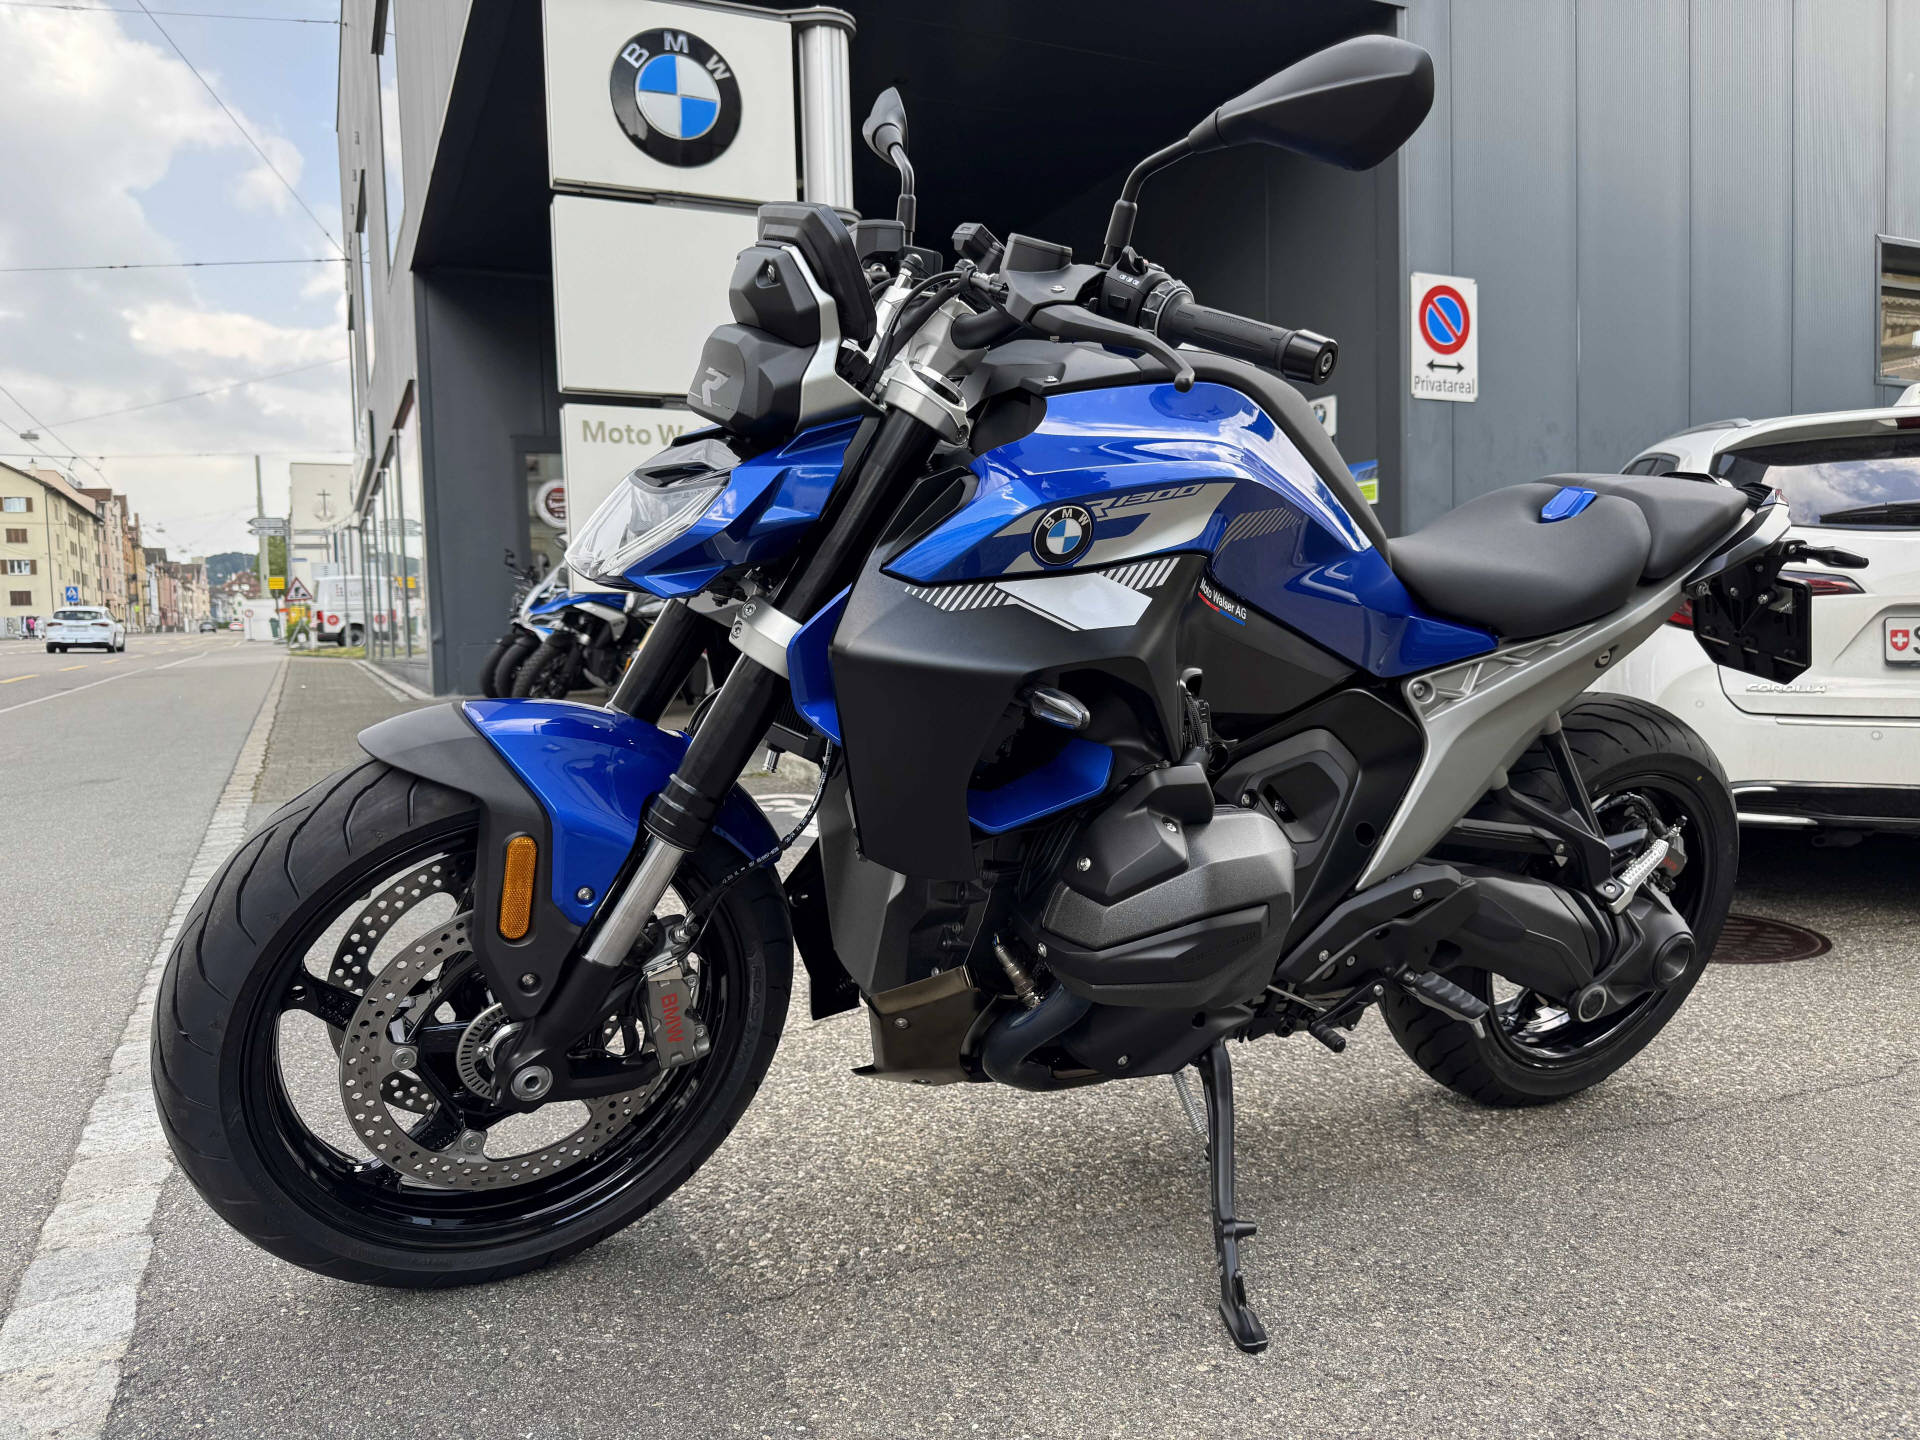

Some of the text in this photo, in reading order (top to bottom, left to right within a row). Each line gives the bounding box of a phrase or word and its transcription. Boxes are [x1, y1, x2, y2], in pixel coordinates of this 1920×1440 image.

[621, 30, 732, 81] BMW
[1414, 376, 1475, 394] Privatareal
[581, 420, 652, 445] Moto
[1042, 508, 1090, 529] BMW
[1199, 576, 1248, 620] Moto Walser AG
[1745, 683, 1826, 694] COROLLA
[660, 992, 687, 1043] BMW
